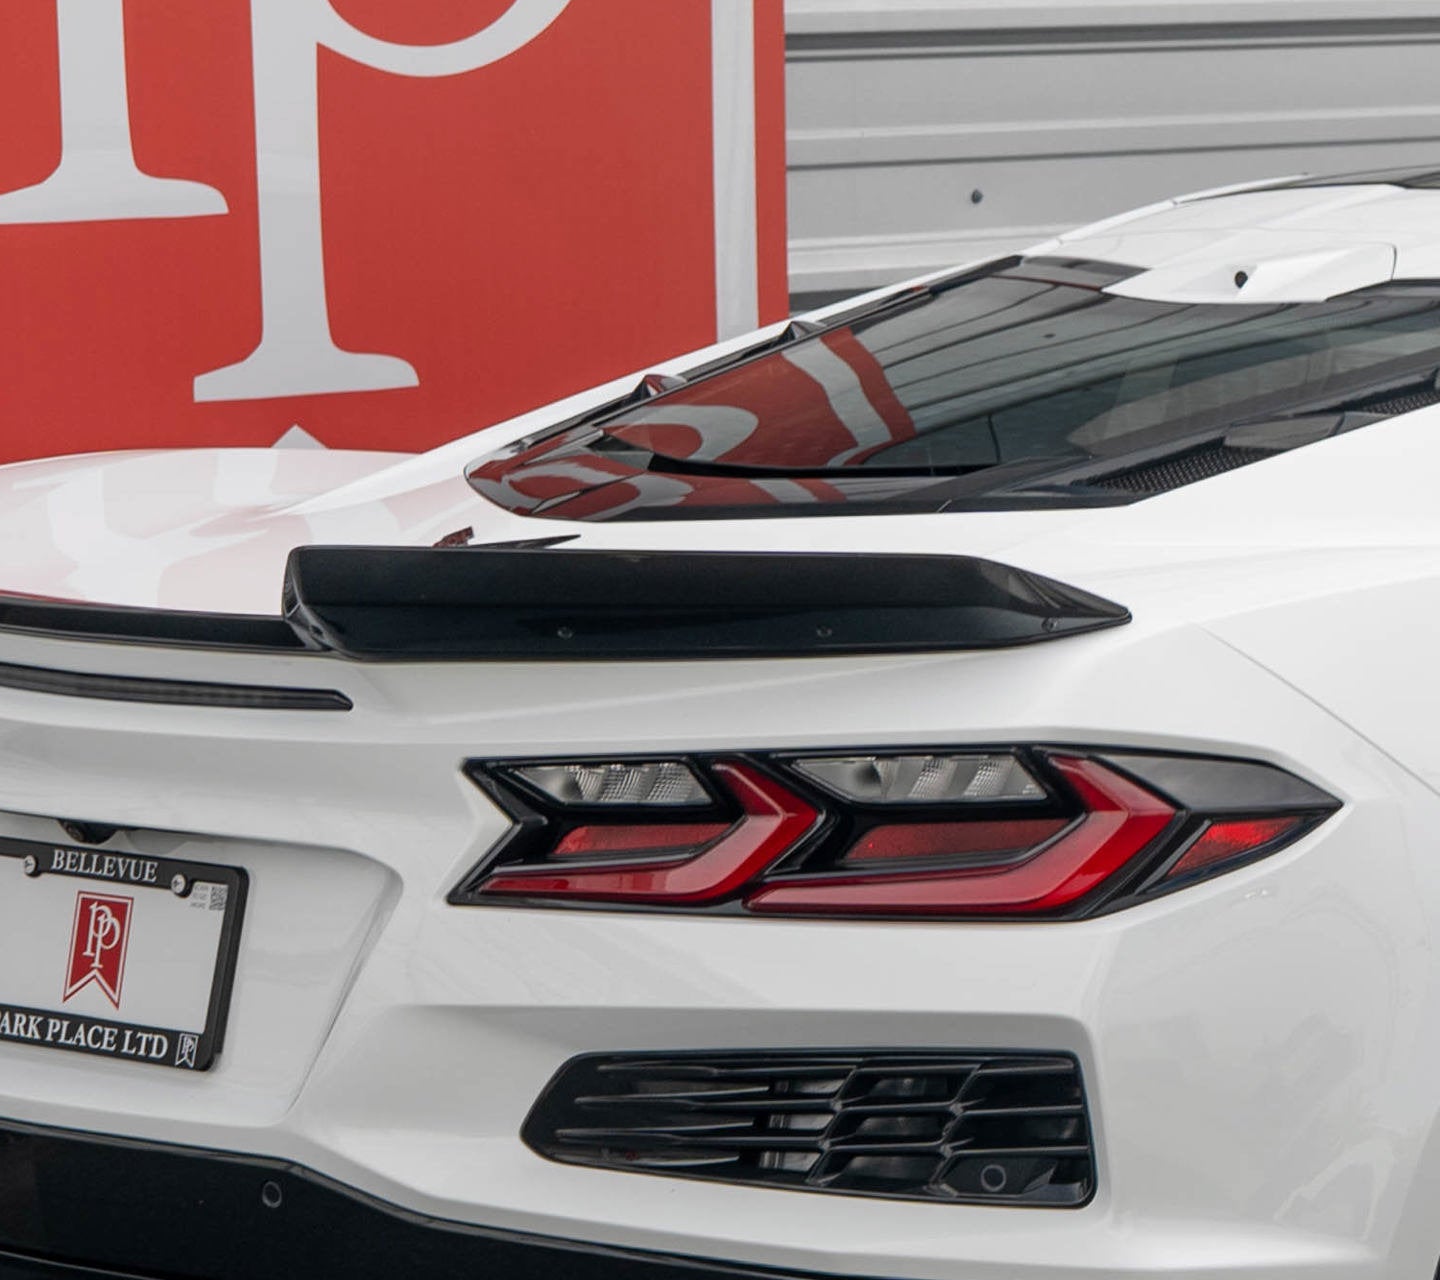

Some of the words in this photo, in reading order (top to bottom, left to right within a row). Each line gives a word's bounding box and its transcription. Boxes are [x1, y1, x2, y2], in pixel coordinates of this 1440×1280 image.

[51, 848, 159, 883] BELLEVUE
[45, 1019, 118, 1052] PLACE
[120, 1030, 169, 1059] LTD
